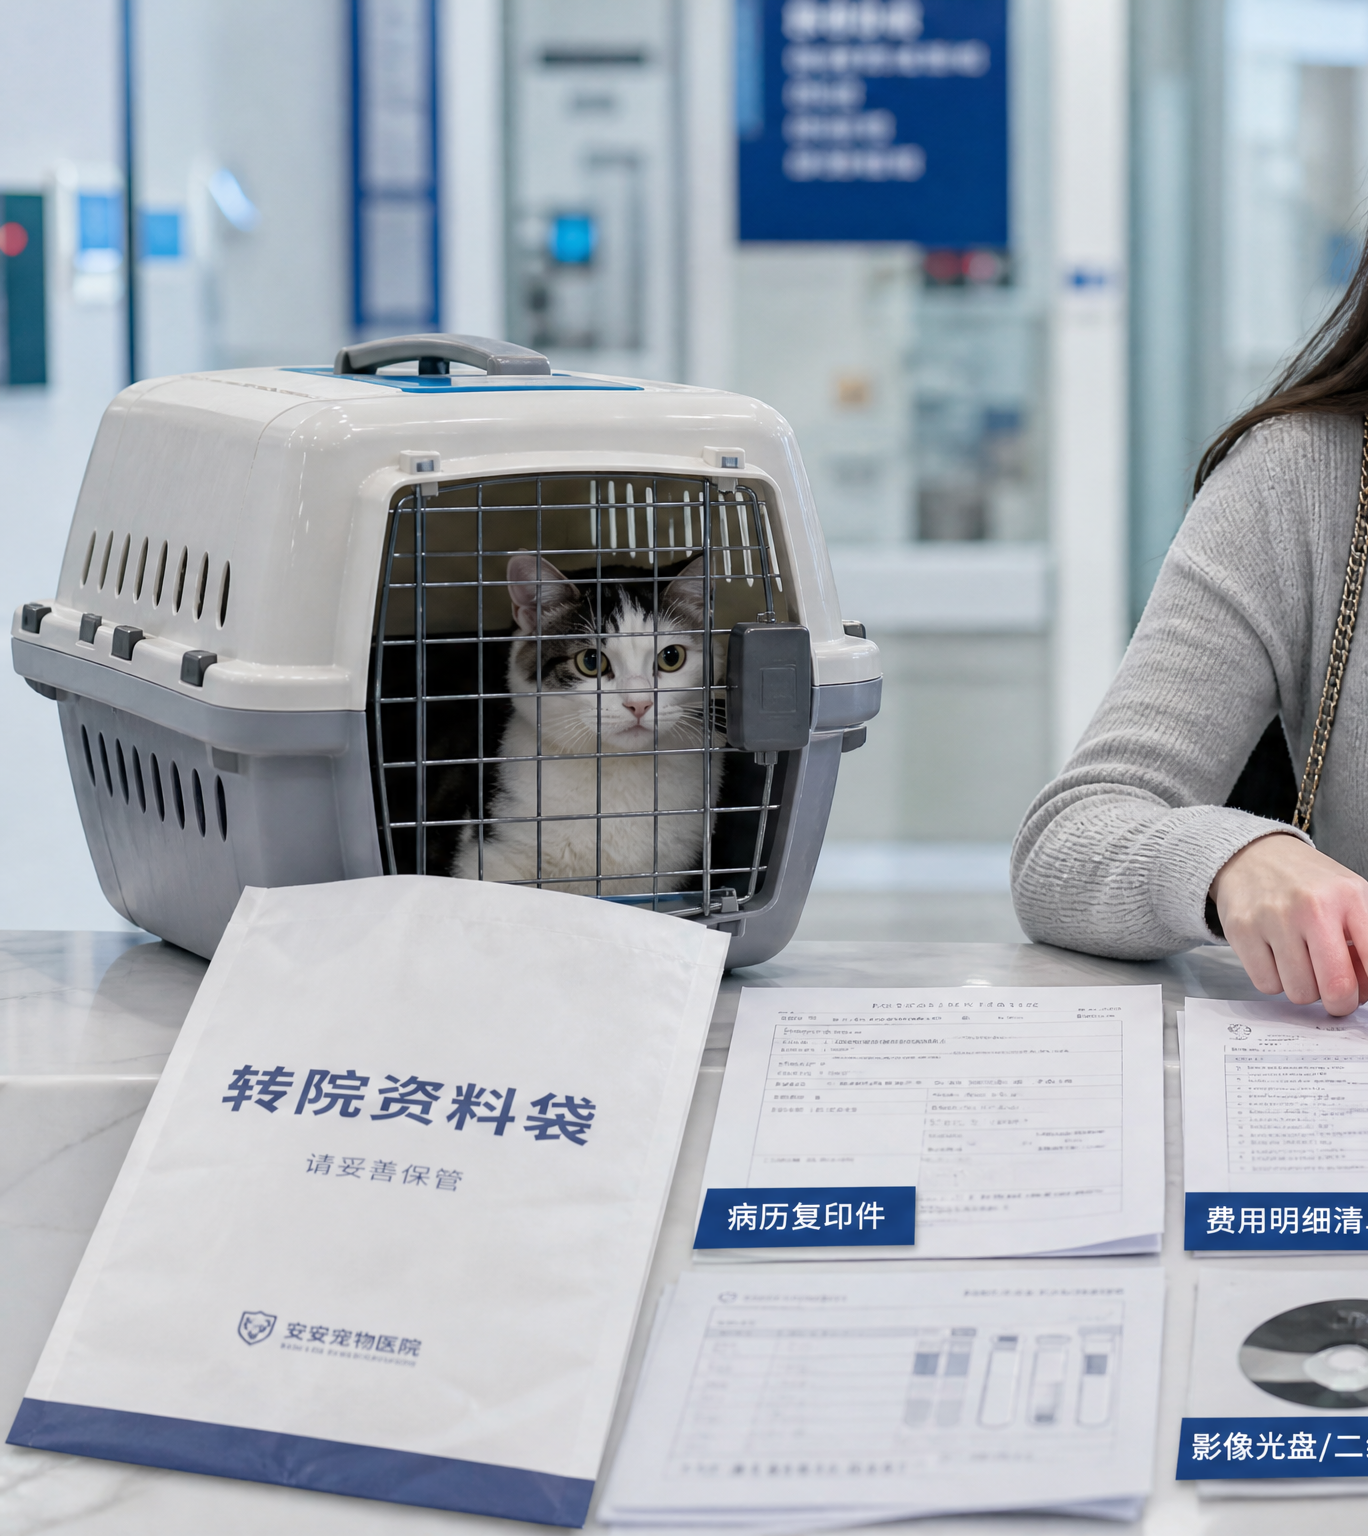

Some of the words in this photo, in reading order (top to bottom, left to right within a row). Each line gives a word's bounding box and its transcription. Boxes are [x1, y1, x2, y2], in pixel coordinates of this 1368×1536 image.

[222, 1064, 596, 1146] 转院资料袋
[305, 1152, 464, 1193] 请妥善保管
[727, 1201, 885, 1231] 病历复印件
[284, 1321, 422, 1357] 安安宠物医院
